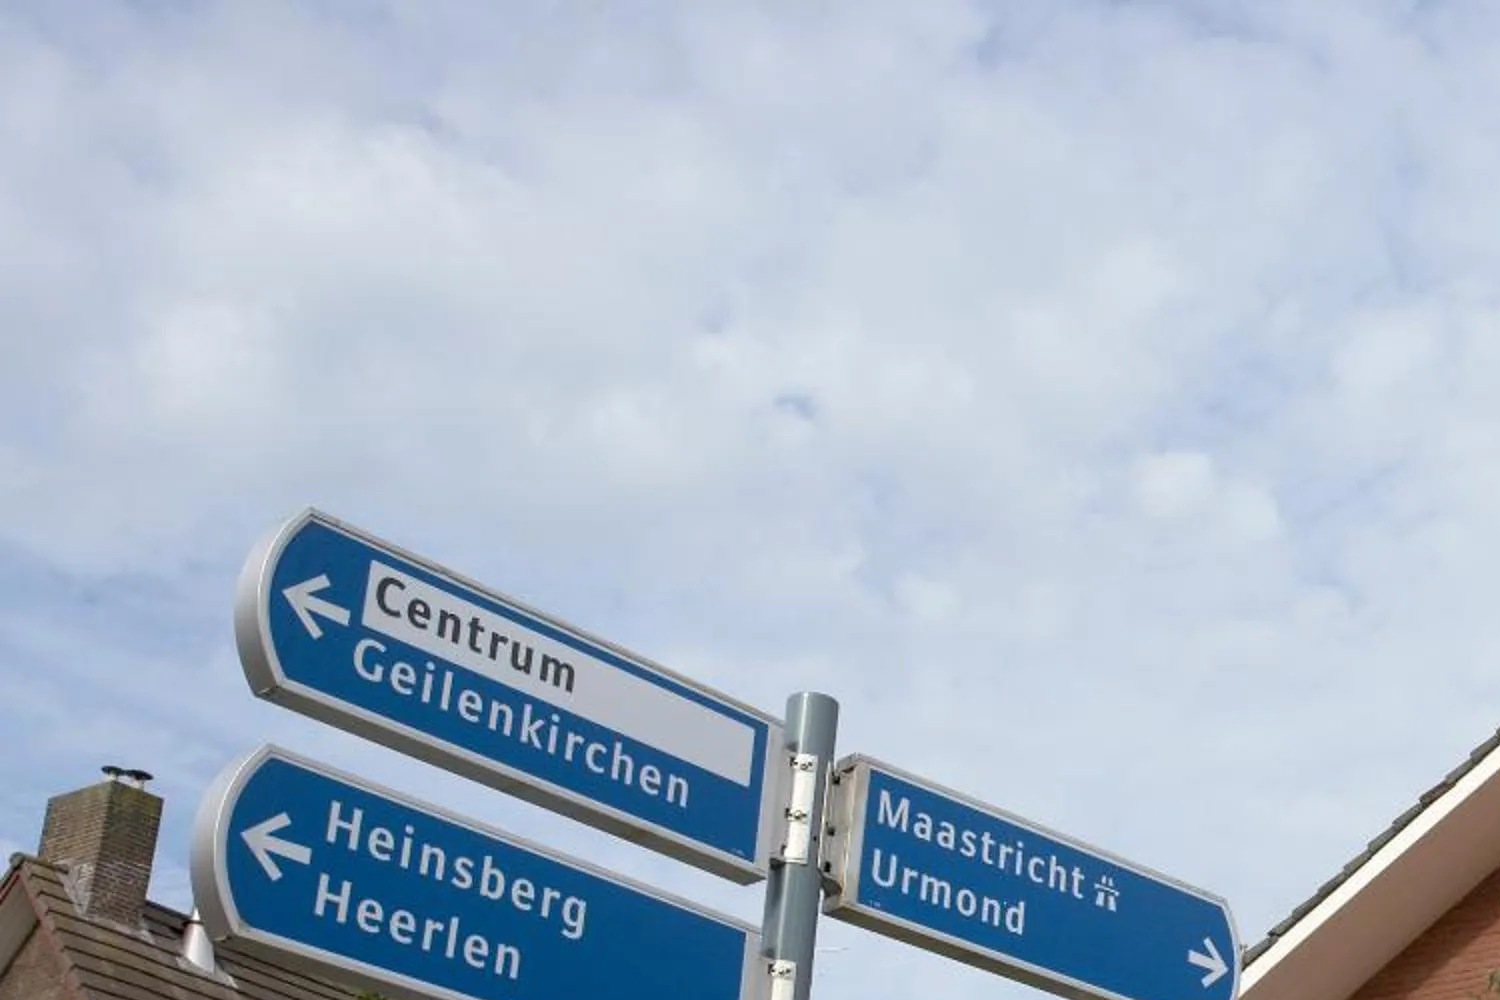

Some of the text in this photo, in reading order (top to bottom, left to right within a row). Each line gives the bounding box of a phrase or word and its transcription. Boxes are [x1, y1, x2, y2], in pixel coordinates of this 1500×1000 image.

[375, 577, 576, 692] Centrum
[353, 638, 689, 807] Geilenkirchen
[325, 800, 588, 940] Heinsberg
[871, 848, 1025, 936] Urmond
[877, 789, 1085, 899] Maastricht
[313, 873, 521, 980] Heerlen
